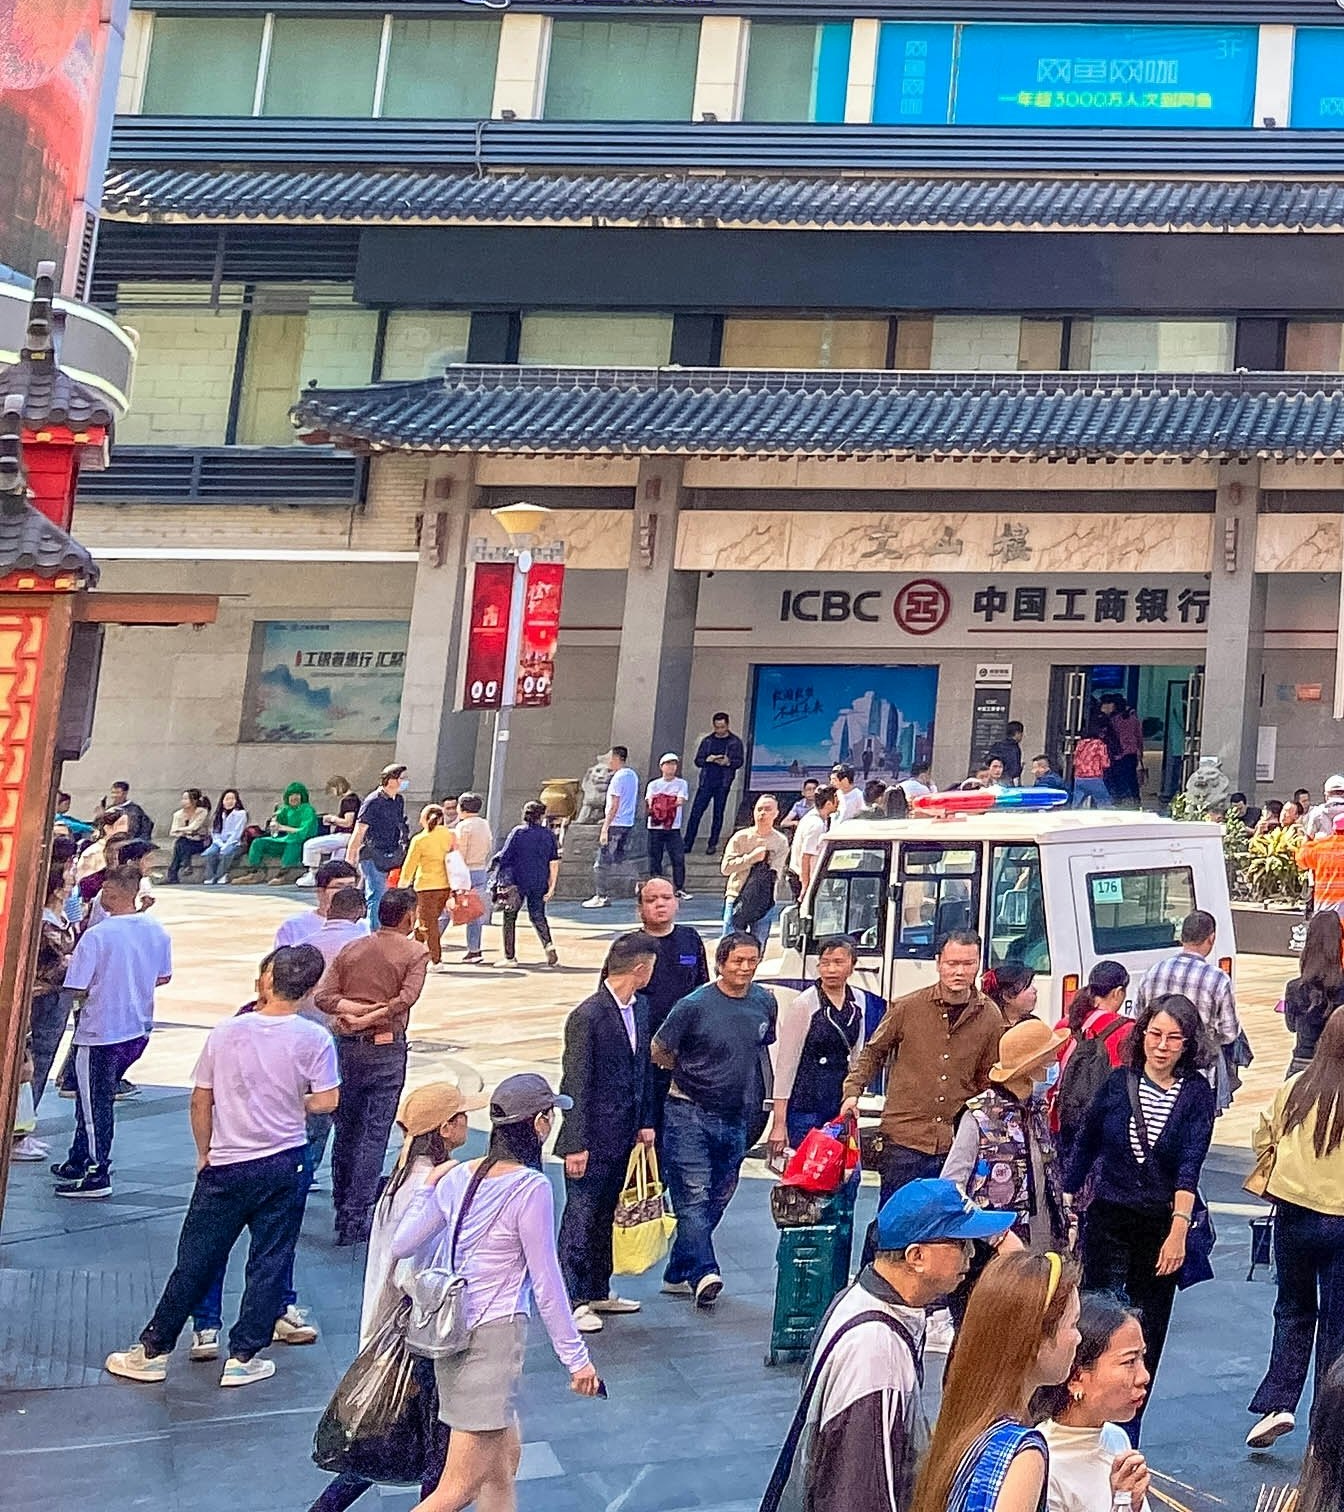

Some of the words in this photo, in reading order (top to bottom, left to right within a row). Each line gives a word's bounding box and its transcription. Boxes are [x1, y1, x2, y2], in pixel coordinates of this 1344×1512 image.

[1036, 57, 1179, 84] 网鱼网咖
[780, 589, 881, 622] ICBC
[1096, 880, 1119, 895] 176
